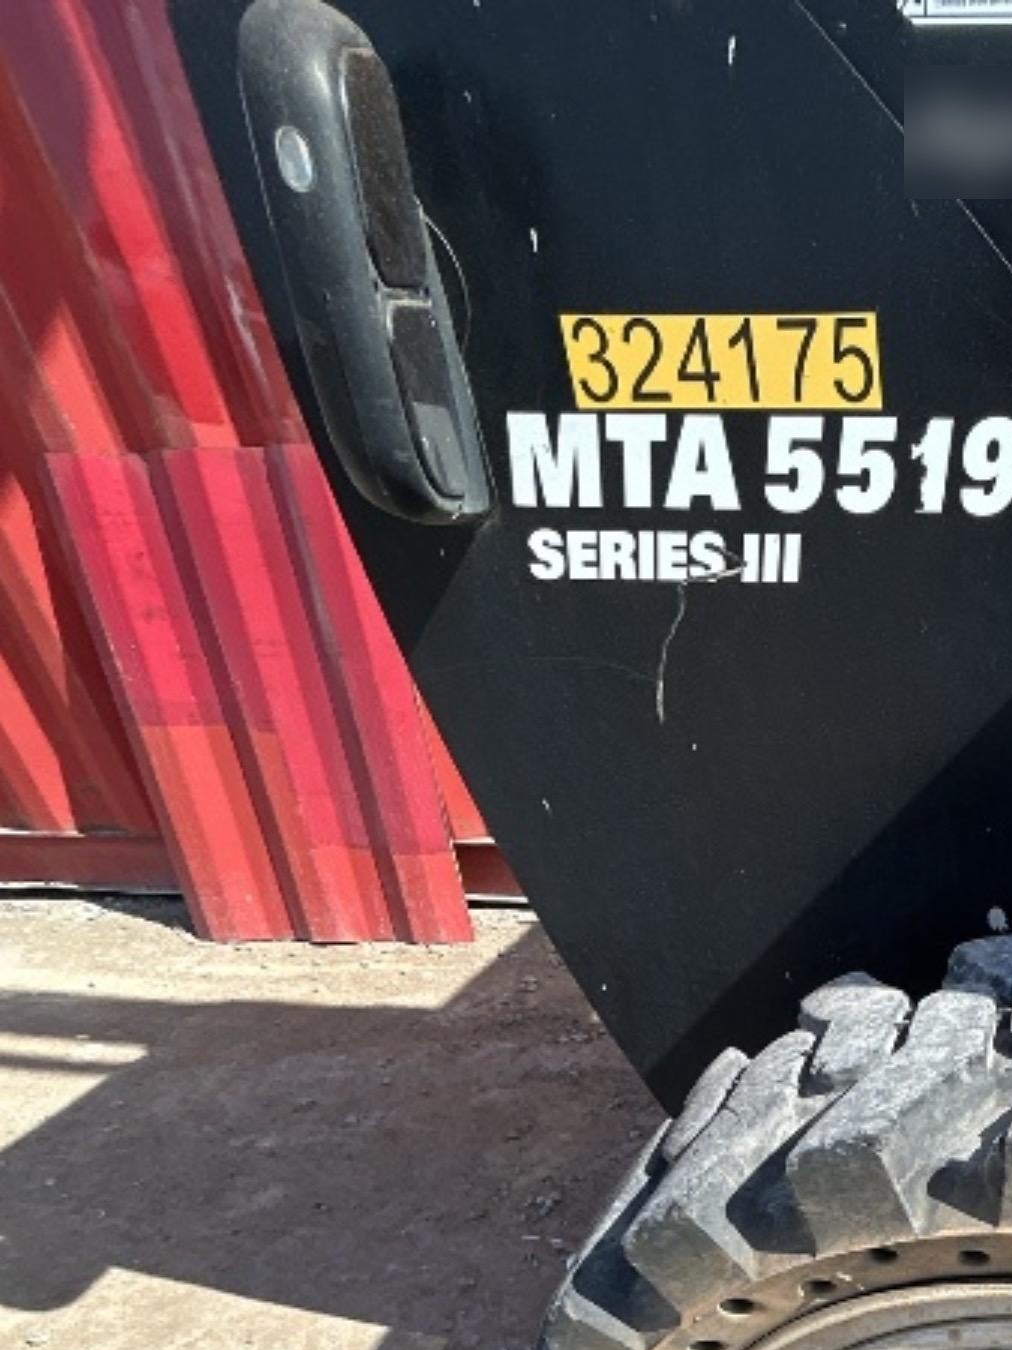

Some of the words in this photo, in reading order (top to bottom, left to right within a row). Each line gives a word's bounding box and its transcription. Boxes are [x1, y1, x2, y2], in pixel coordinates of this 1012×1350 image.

[571, 317, 874, 403] 324175
[506, 411, 742, 511] MTA
[527, 527, 727, 582] SERIES
[741, 532, 802, 584] III
